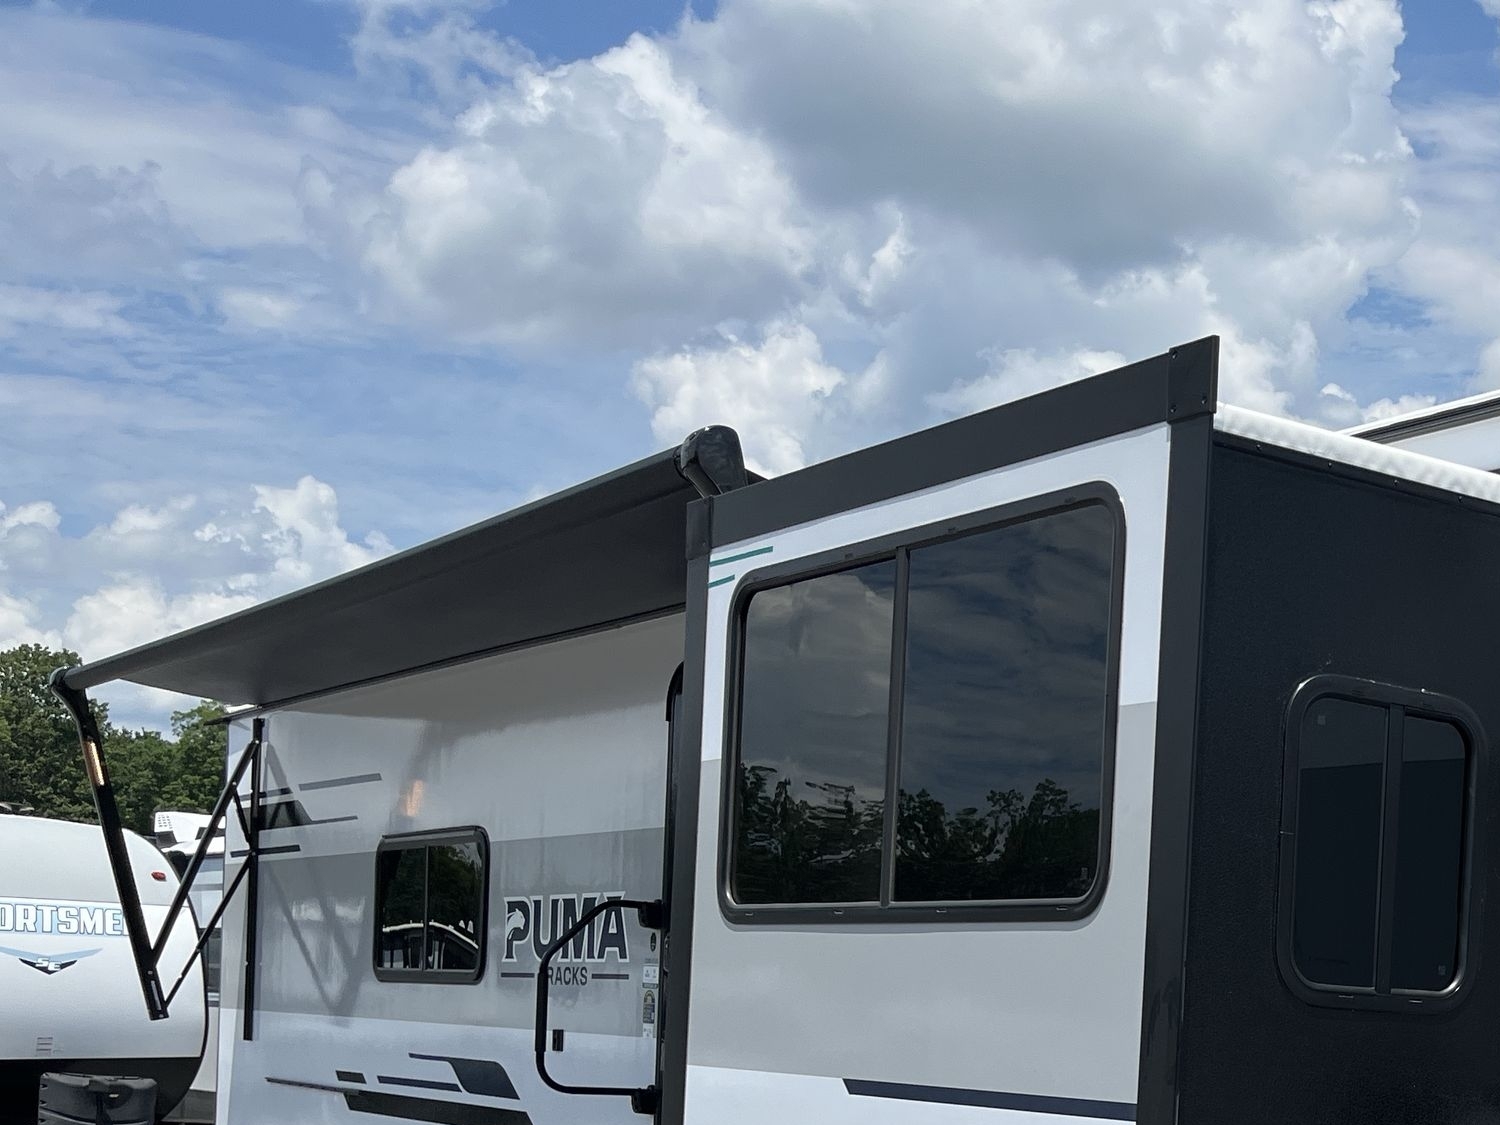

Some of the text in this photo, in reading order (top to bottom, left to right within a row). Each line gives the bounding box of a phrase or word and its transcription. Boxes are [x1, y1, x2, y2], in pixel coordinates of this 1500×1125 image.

[0, 903, 129, 936] ORTSME
[502, 891, 630, 962] PUMA
[35, 957, 61, 971] SE
[547, 966, 588, 986] RACKS
